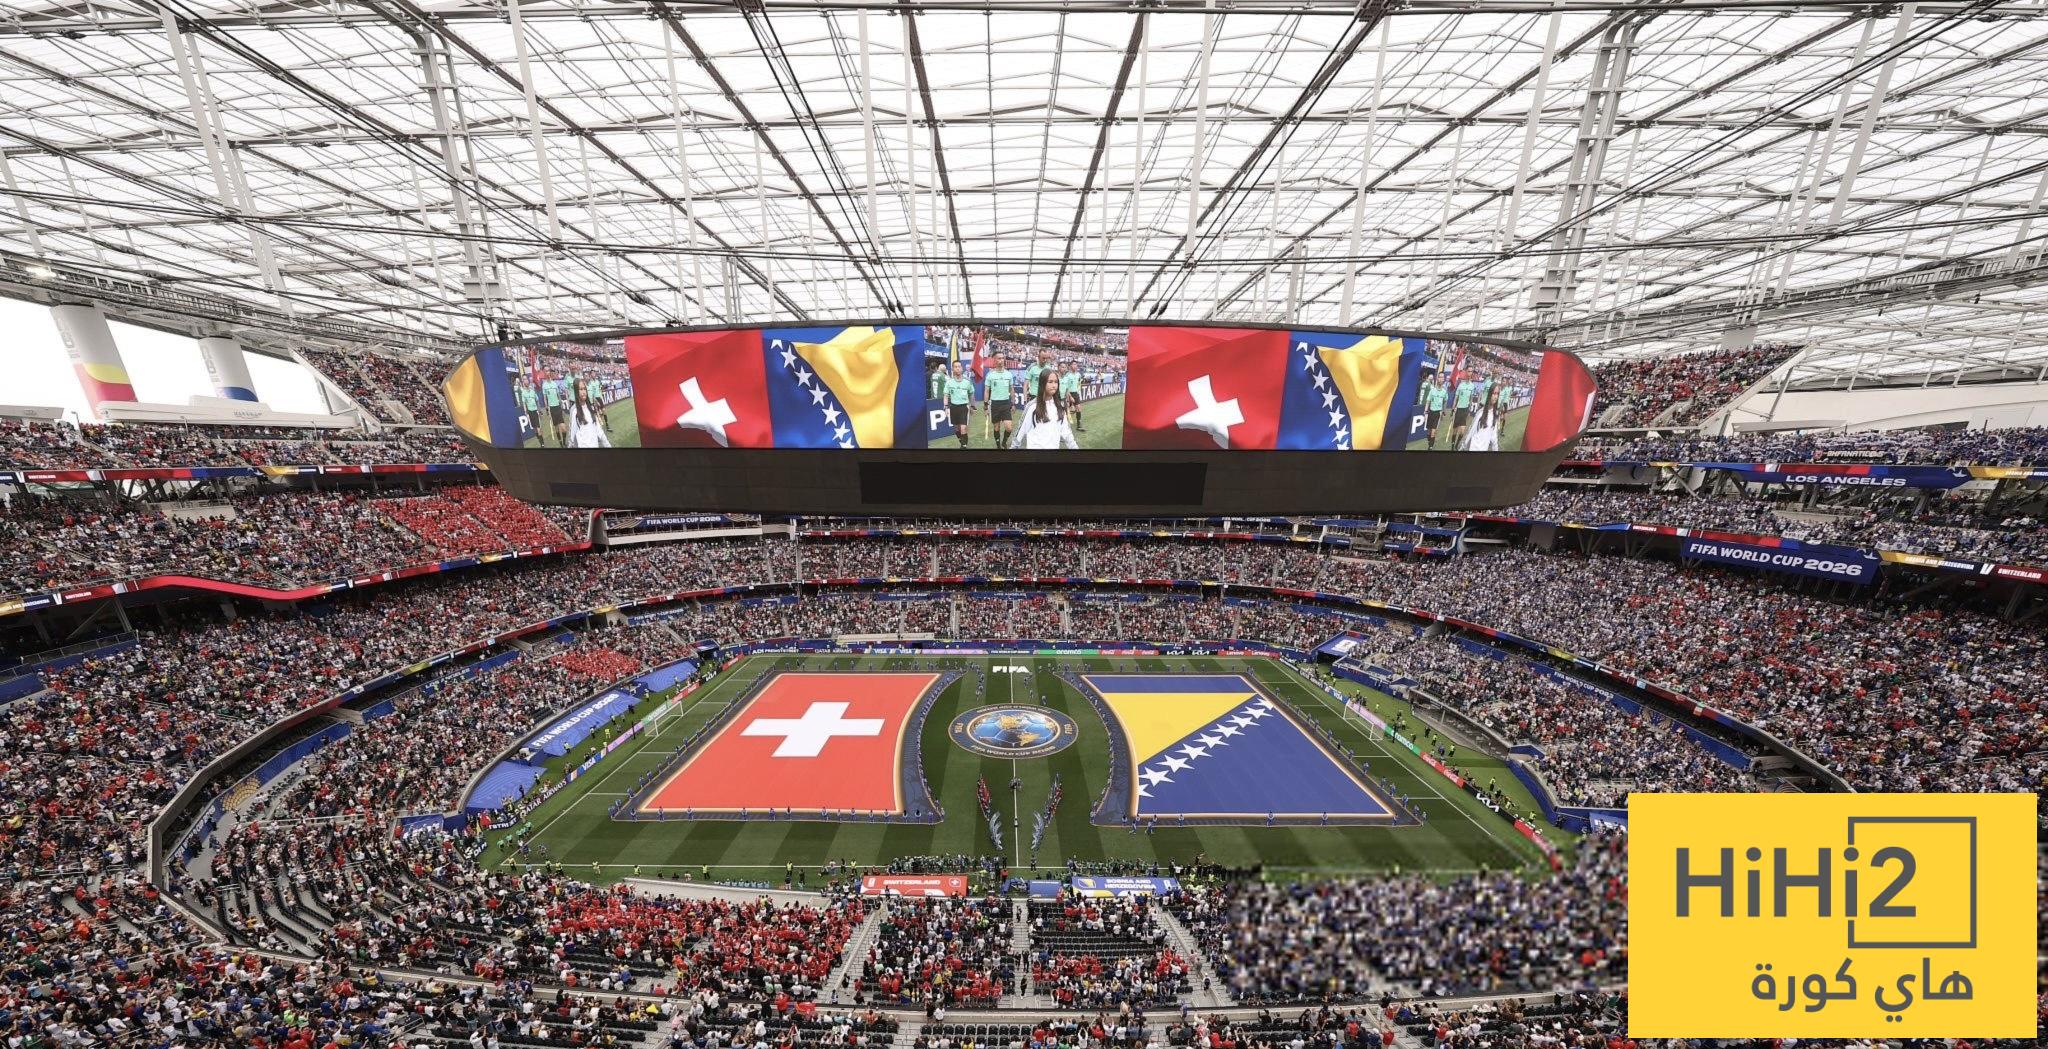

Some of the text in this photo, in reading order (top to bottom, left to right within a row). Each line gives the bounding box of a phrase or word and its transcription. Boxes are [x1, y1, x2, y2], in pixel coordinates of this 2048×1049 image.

[1786, 475, 1907, 486] LOS ANGELES
[1690, 544, 1862, 576] FIFA WORLD CUP 2026
[1998, 568, 2042, 579] SWITZERLAND
[992, 665, 1029, 673] FIFA
[1583, 682, 1596, 691] CUP
[532, 733, 556, 746] FIFA
[549, 717, 581, 735] WORLD
[578, 707, 594, 718] CUP
[582, 757, 596, 770] VISA
[543, 780, 567, 801] AIRWAYS
